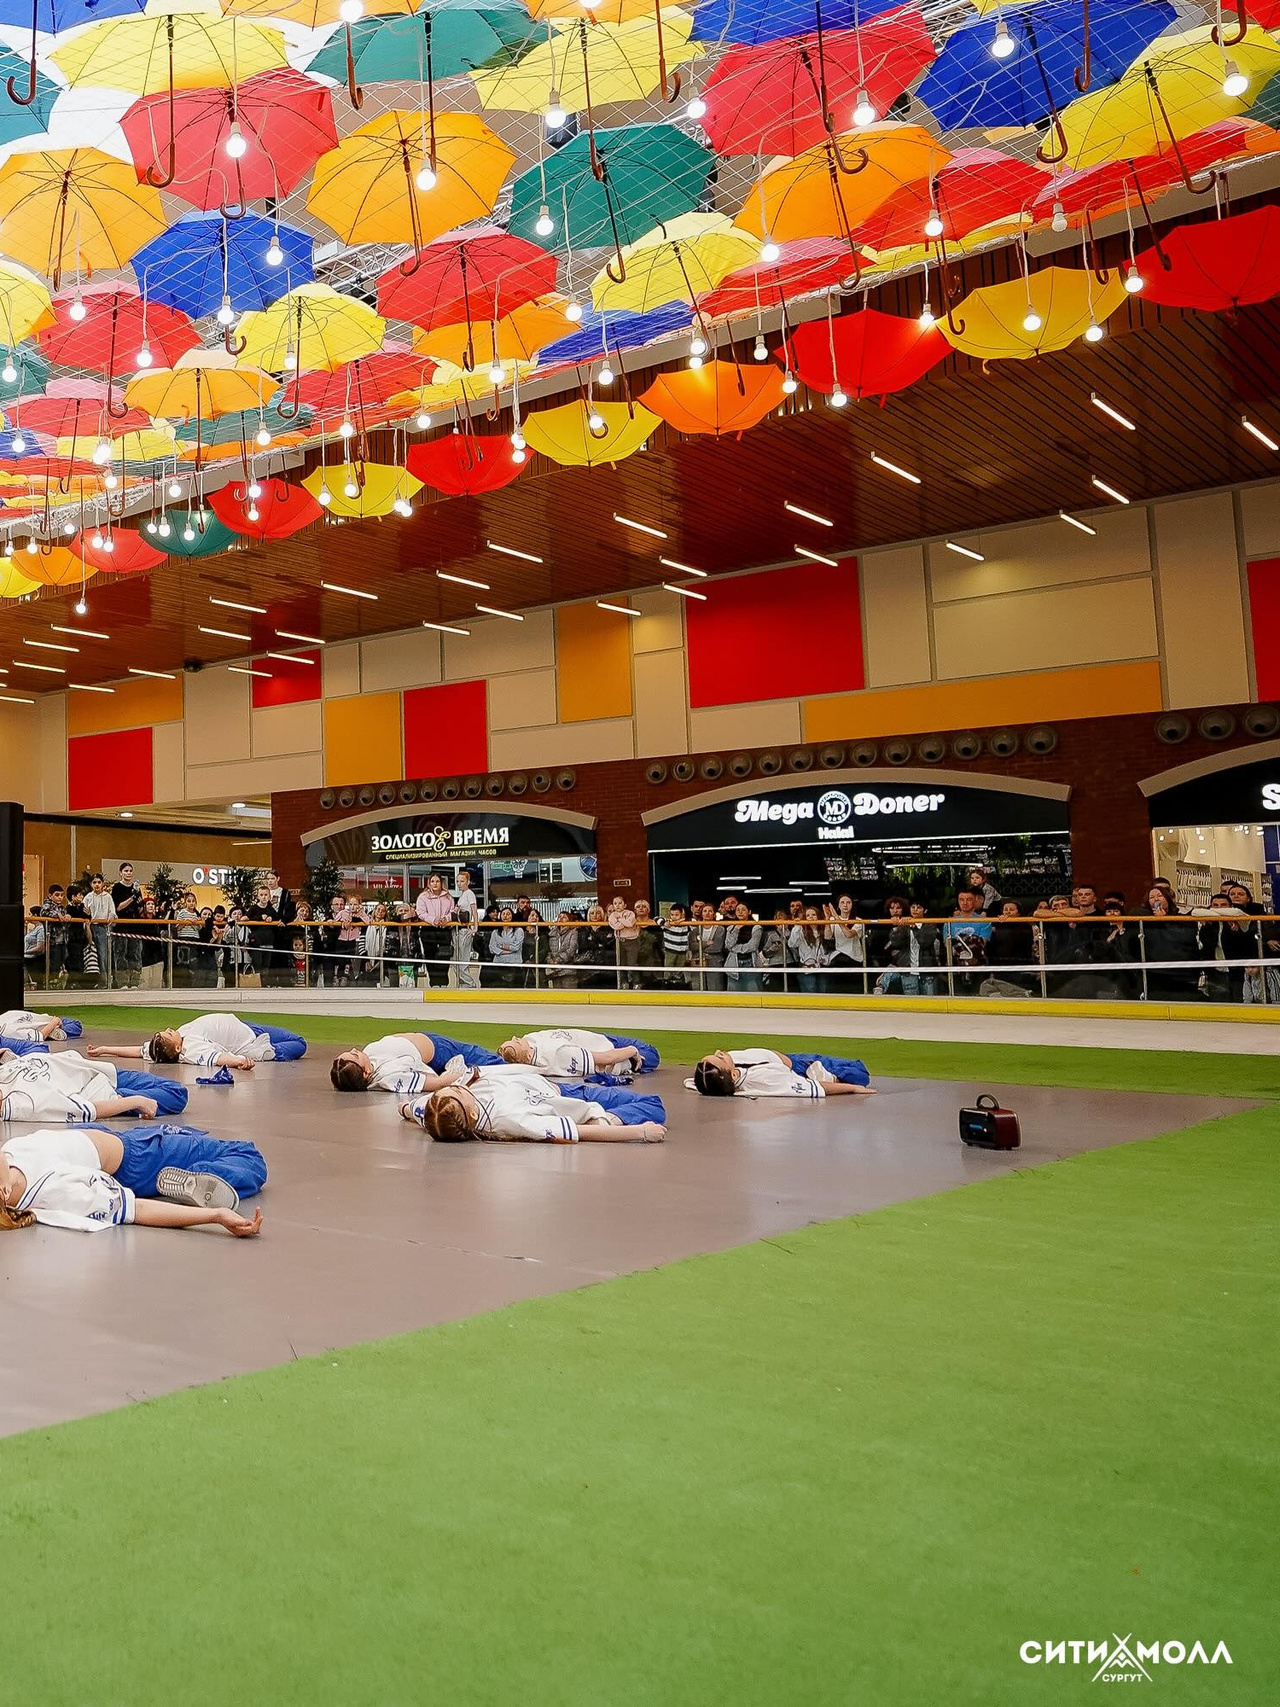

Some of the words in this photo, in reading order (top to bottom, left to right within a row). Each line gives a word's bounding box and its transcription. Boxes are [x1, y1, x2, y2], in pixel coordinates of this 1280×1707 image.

[735, 800, 813, 825] Mega
[854, 792, 945, 816] Doner
[825, 800, 845, 815] MD
[372, 832, 435, 850] ЗОЛОТО
[453, 827, 509, 845] ВРЕМЯ
[818, 825, 854, 839] Halal
